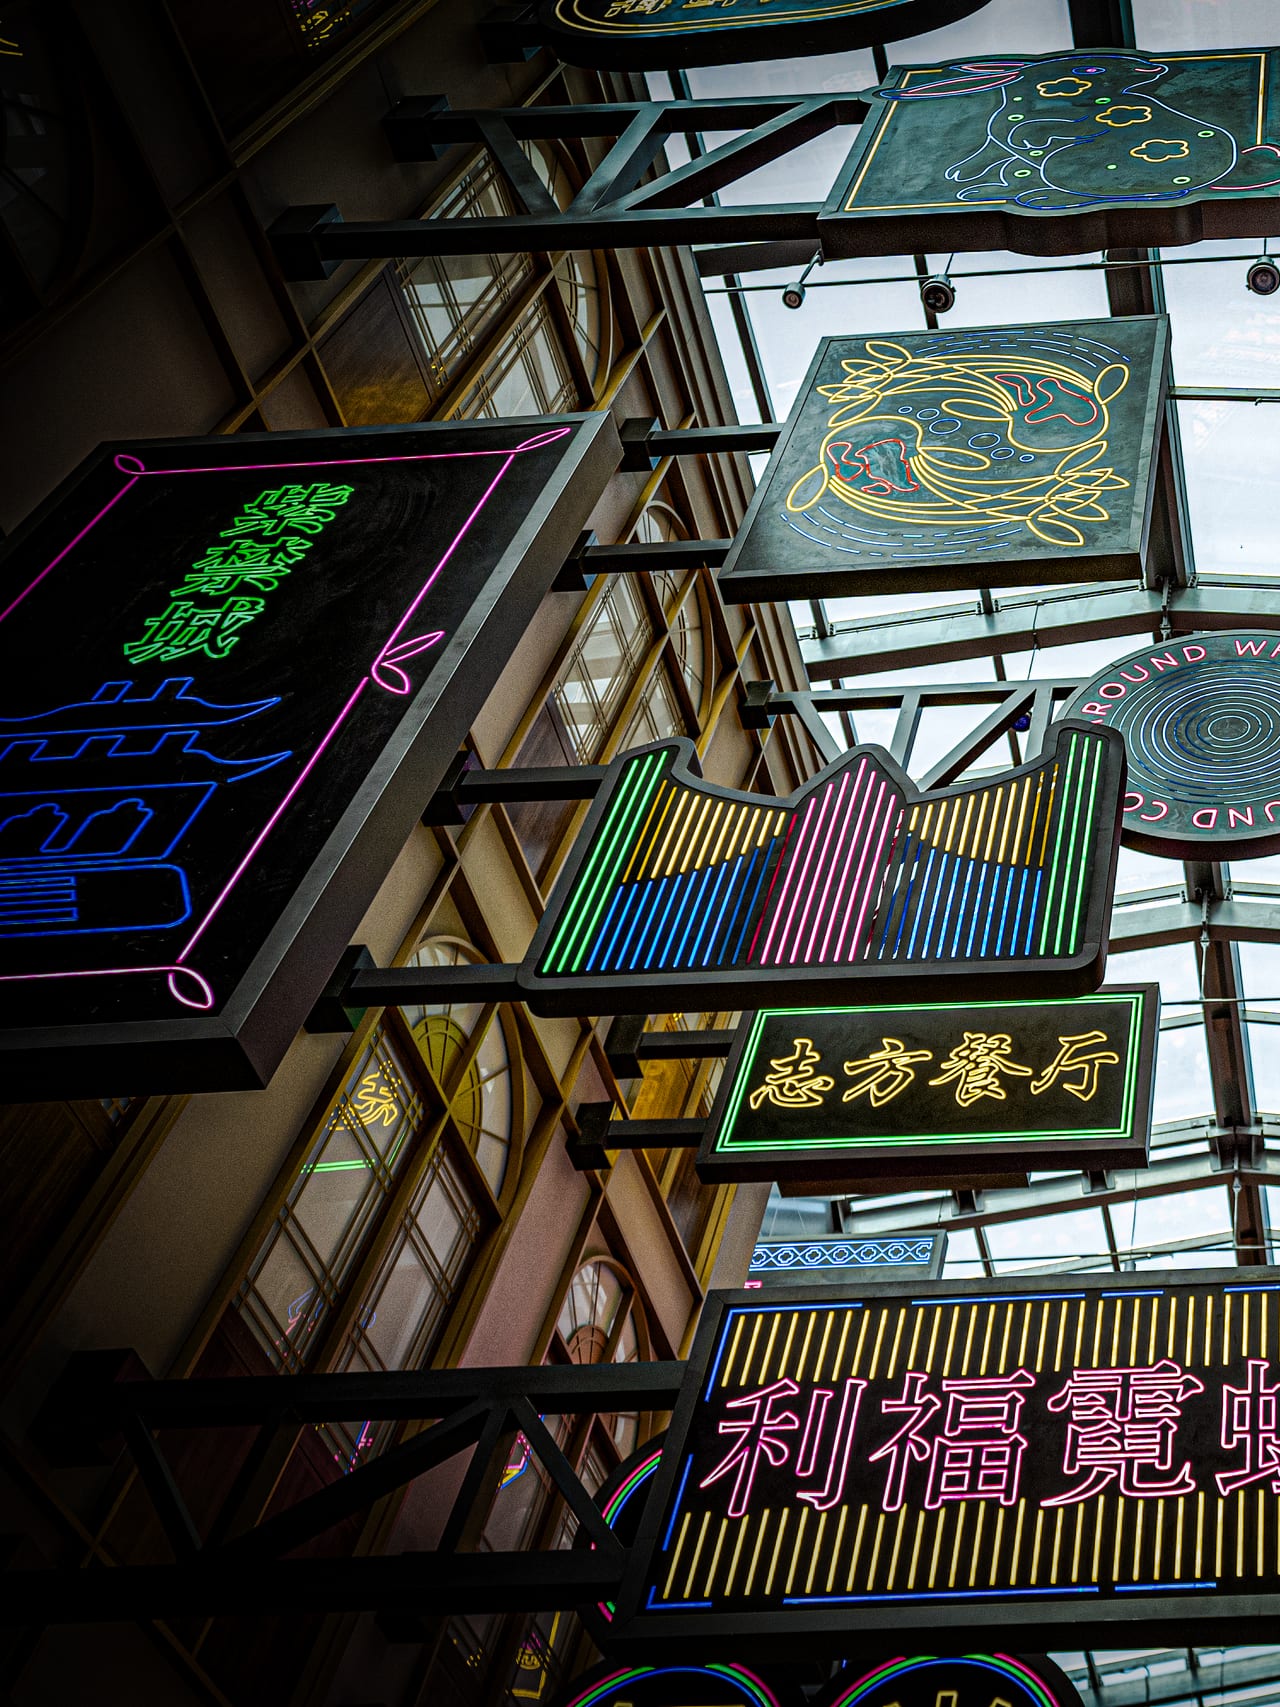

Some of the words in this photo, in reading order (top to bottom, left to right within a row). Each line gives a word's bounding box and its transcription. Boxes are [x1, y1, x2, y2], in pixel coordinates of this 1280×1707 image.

[123, 482, 356, 665] 紫禁城
[1080, 643, 1208, 725] ROUND
[748, 1029, 1121, 1110] 志方餐厅
